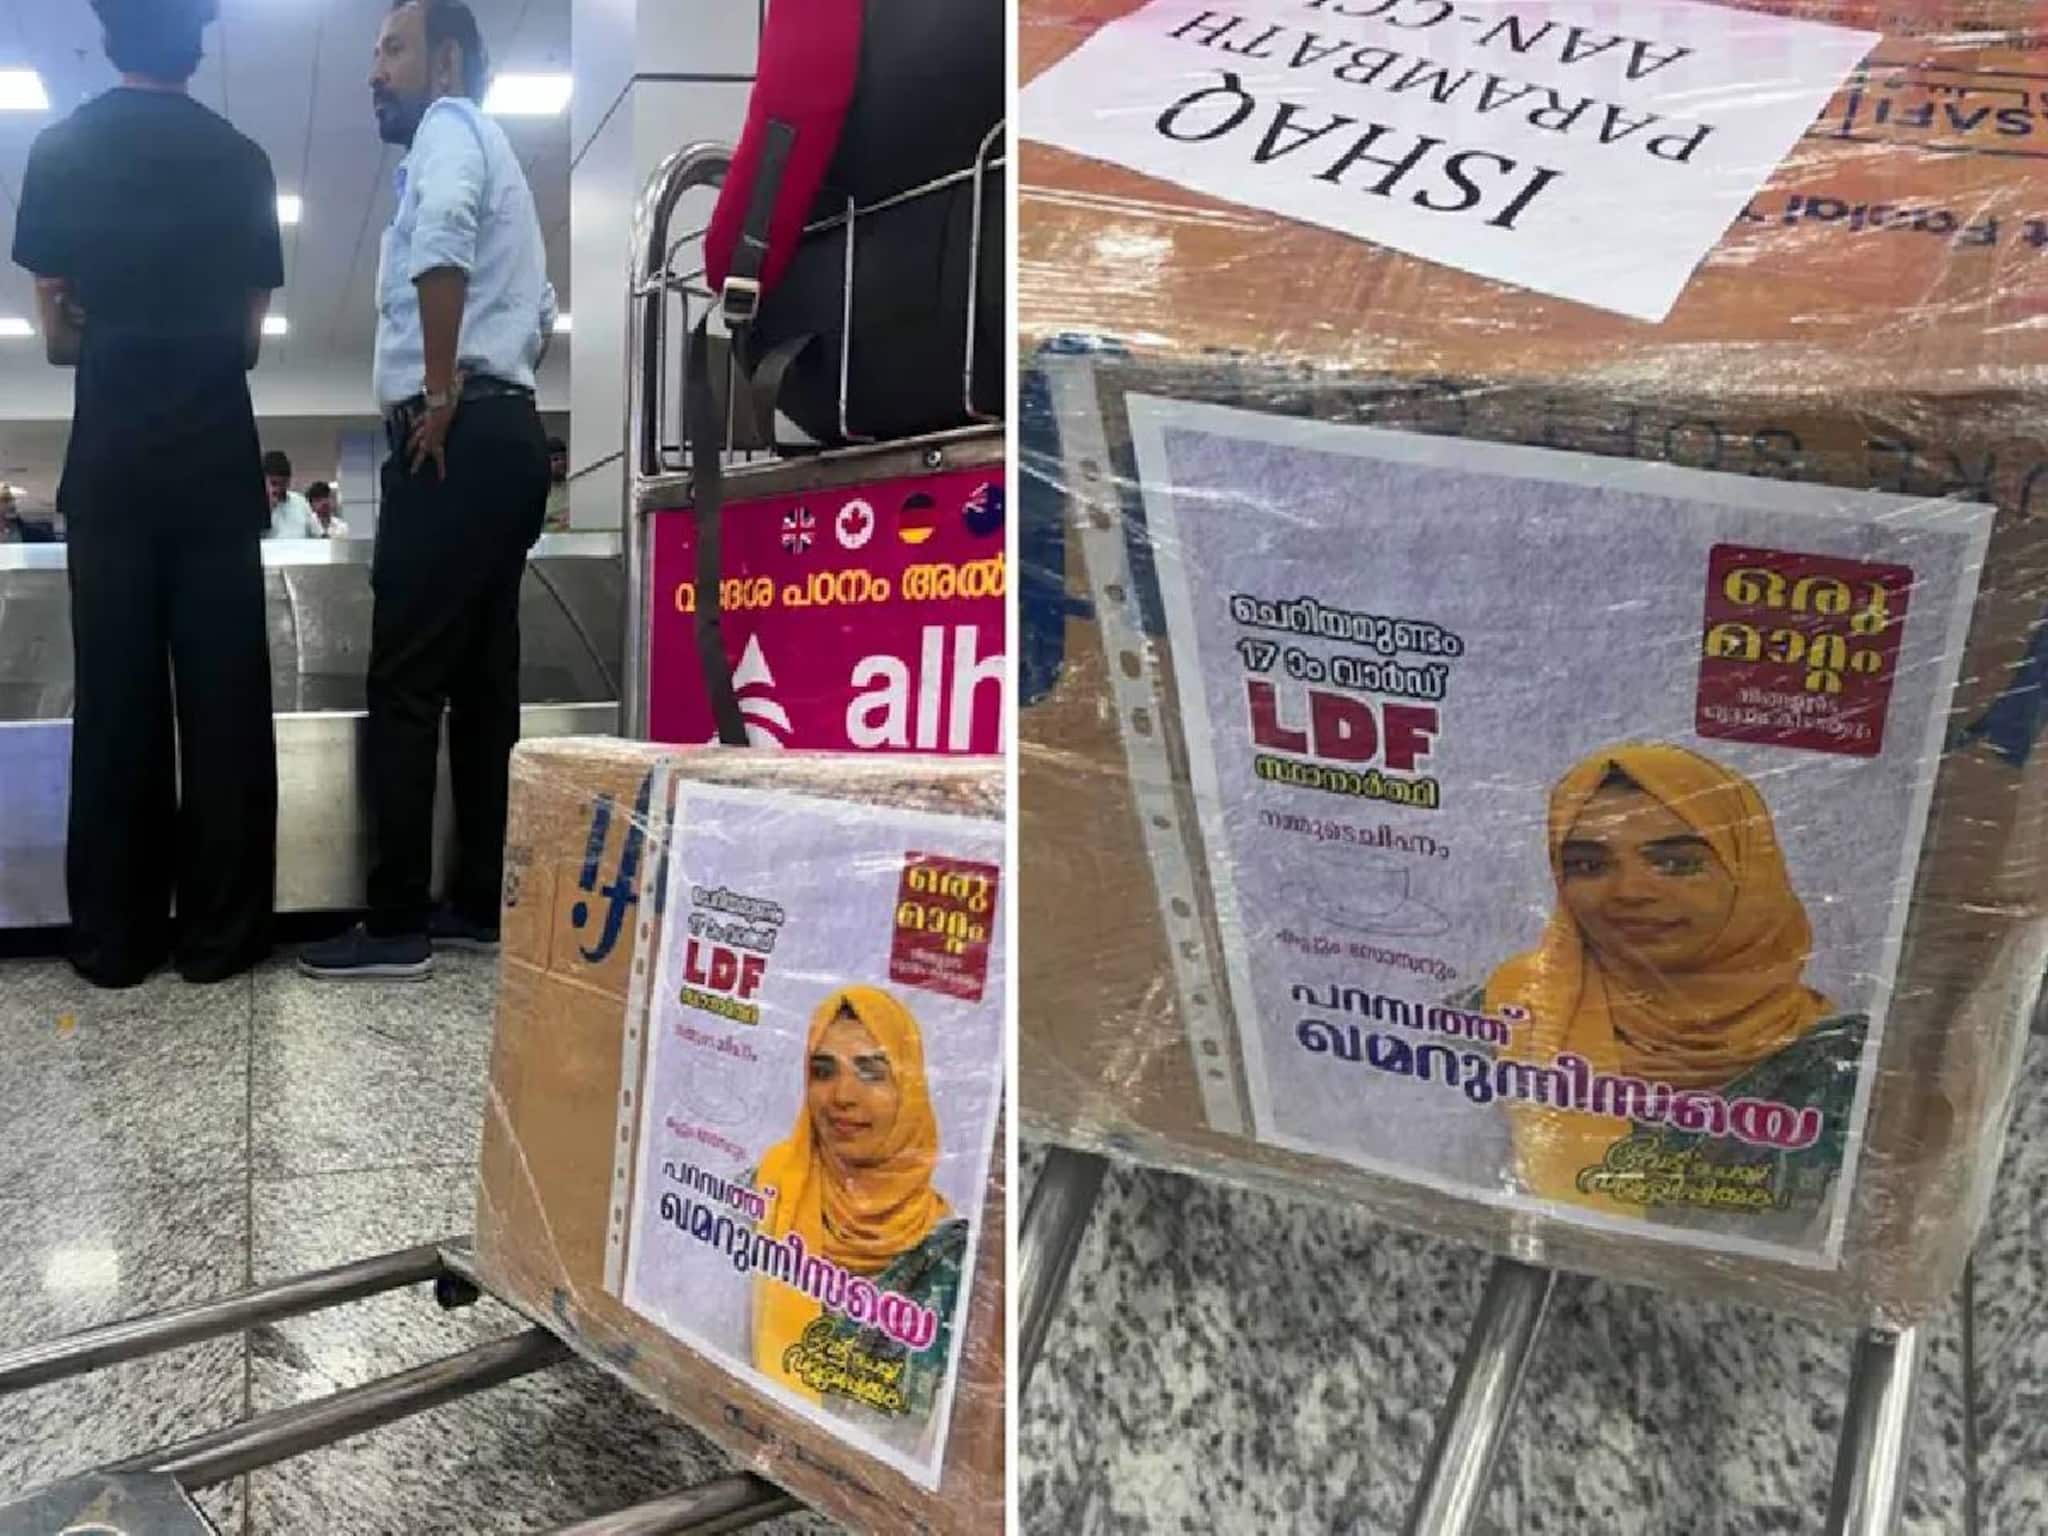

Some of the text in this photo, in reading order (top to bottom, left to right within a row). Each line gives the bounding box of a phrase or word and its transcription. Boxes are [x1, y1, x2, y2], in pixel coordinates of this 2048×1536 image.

[1308, 0, 1692, 79] AAN-C
[1167, 10, 1714, 164] PARAMBATH
[1874, 96, 2048, 136] SAFI
[1156, 69, 1564, 231] ISHAQ
[782, 568, 891, 606] പഠനം
[1724, 567, 1888, 634] ഒരു
[1237, 637, 1279, 672] 17
[1703, 622, 1883, 694] മാറ്റം
[1247, 679, 1439, 773] LDF
[908, 867, 989, 913] ഒരു
[683, 938, 768, 999] LDF
[1291, 983, 1530, 1047] പറമ്പത്ത്
